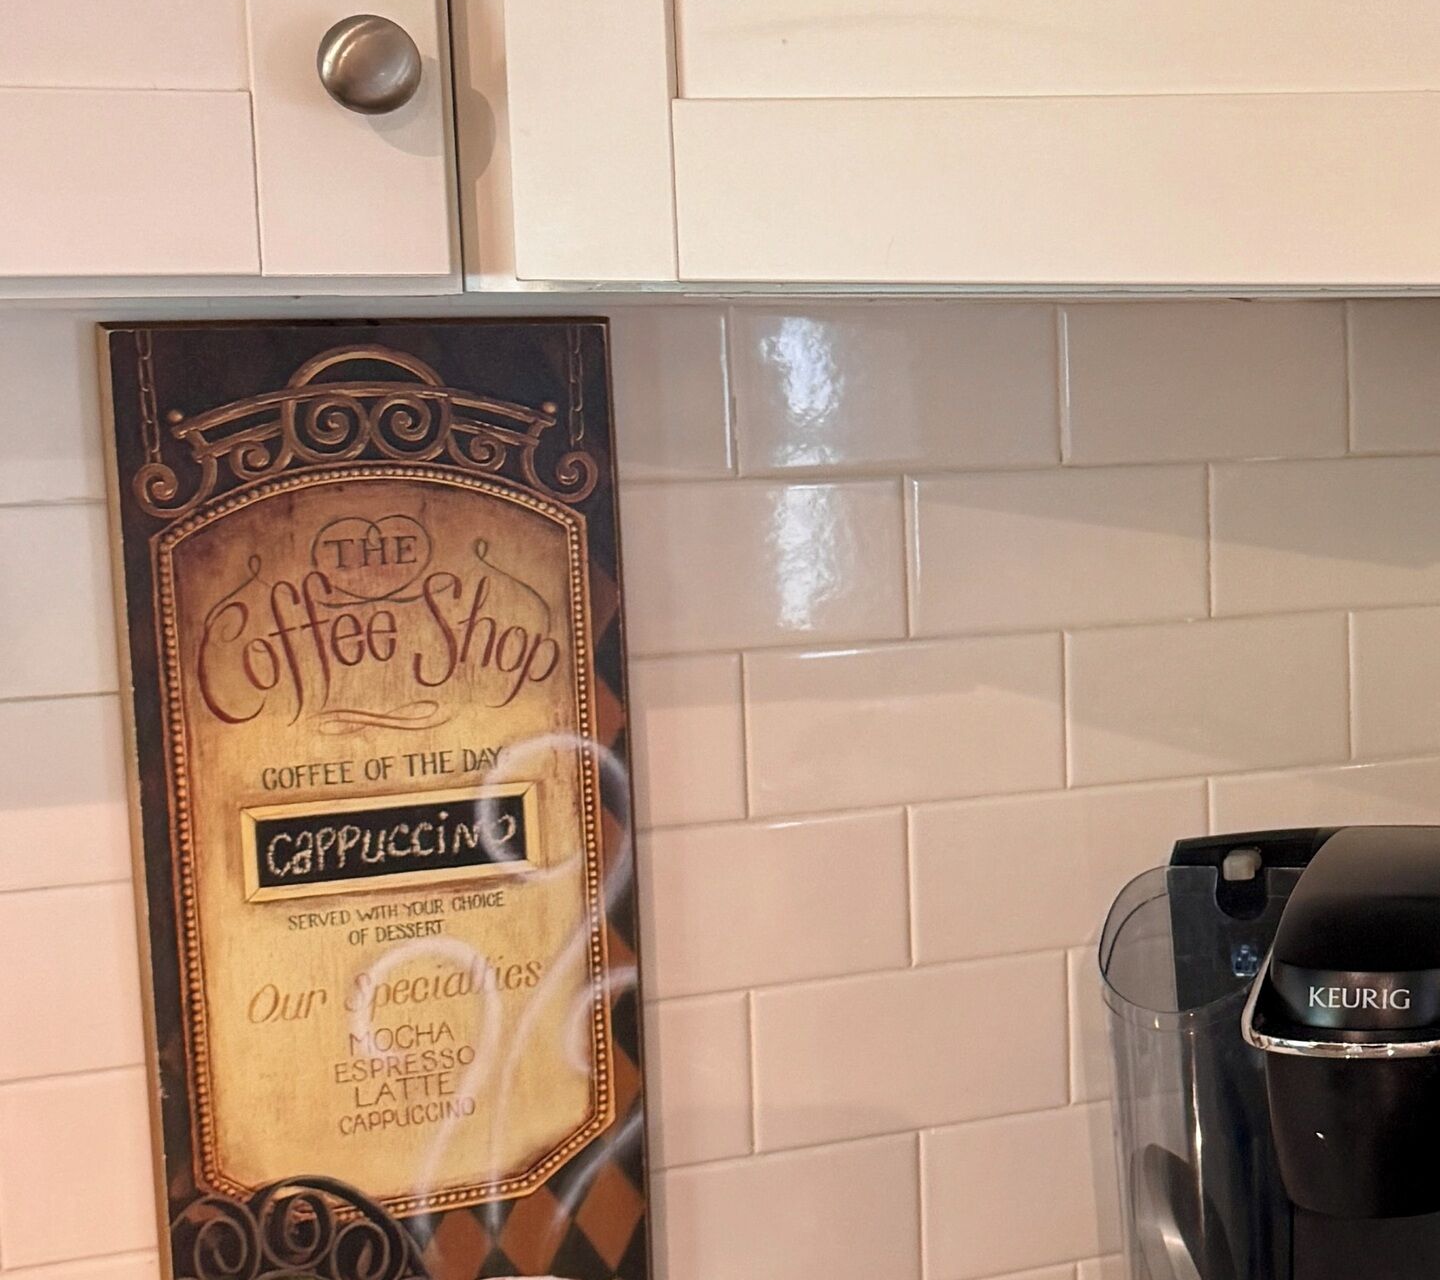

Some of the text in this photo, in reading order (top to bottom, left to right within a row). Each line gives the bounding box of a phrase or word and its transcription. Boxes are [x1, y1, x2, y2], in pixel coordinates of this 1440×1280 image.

[324, 535, 418, 569] THE
[198, 571, 560, 727] Coffee Shop
[262, 745, 503, 792] COFFEE OF THE DAY
[287, 891, 505, 931] SERVED WITH YOUR CHOICE
[348, 919, 446, 946] OF DESSERT
[247, 983, 327, 1024] Our
[1309, 986, 1411, 1010] KEURIG
[349, 1021, 455, 1057] MOCHA
[334, 1045, 476, 1084] ESPRESSO
[354, 1071, 456, 1108] LATTE
[338, 1096, 476, 1136] CAPPUCCINO
